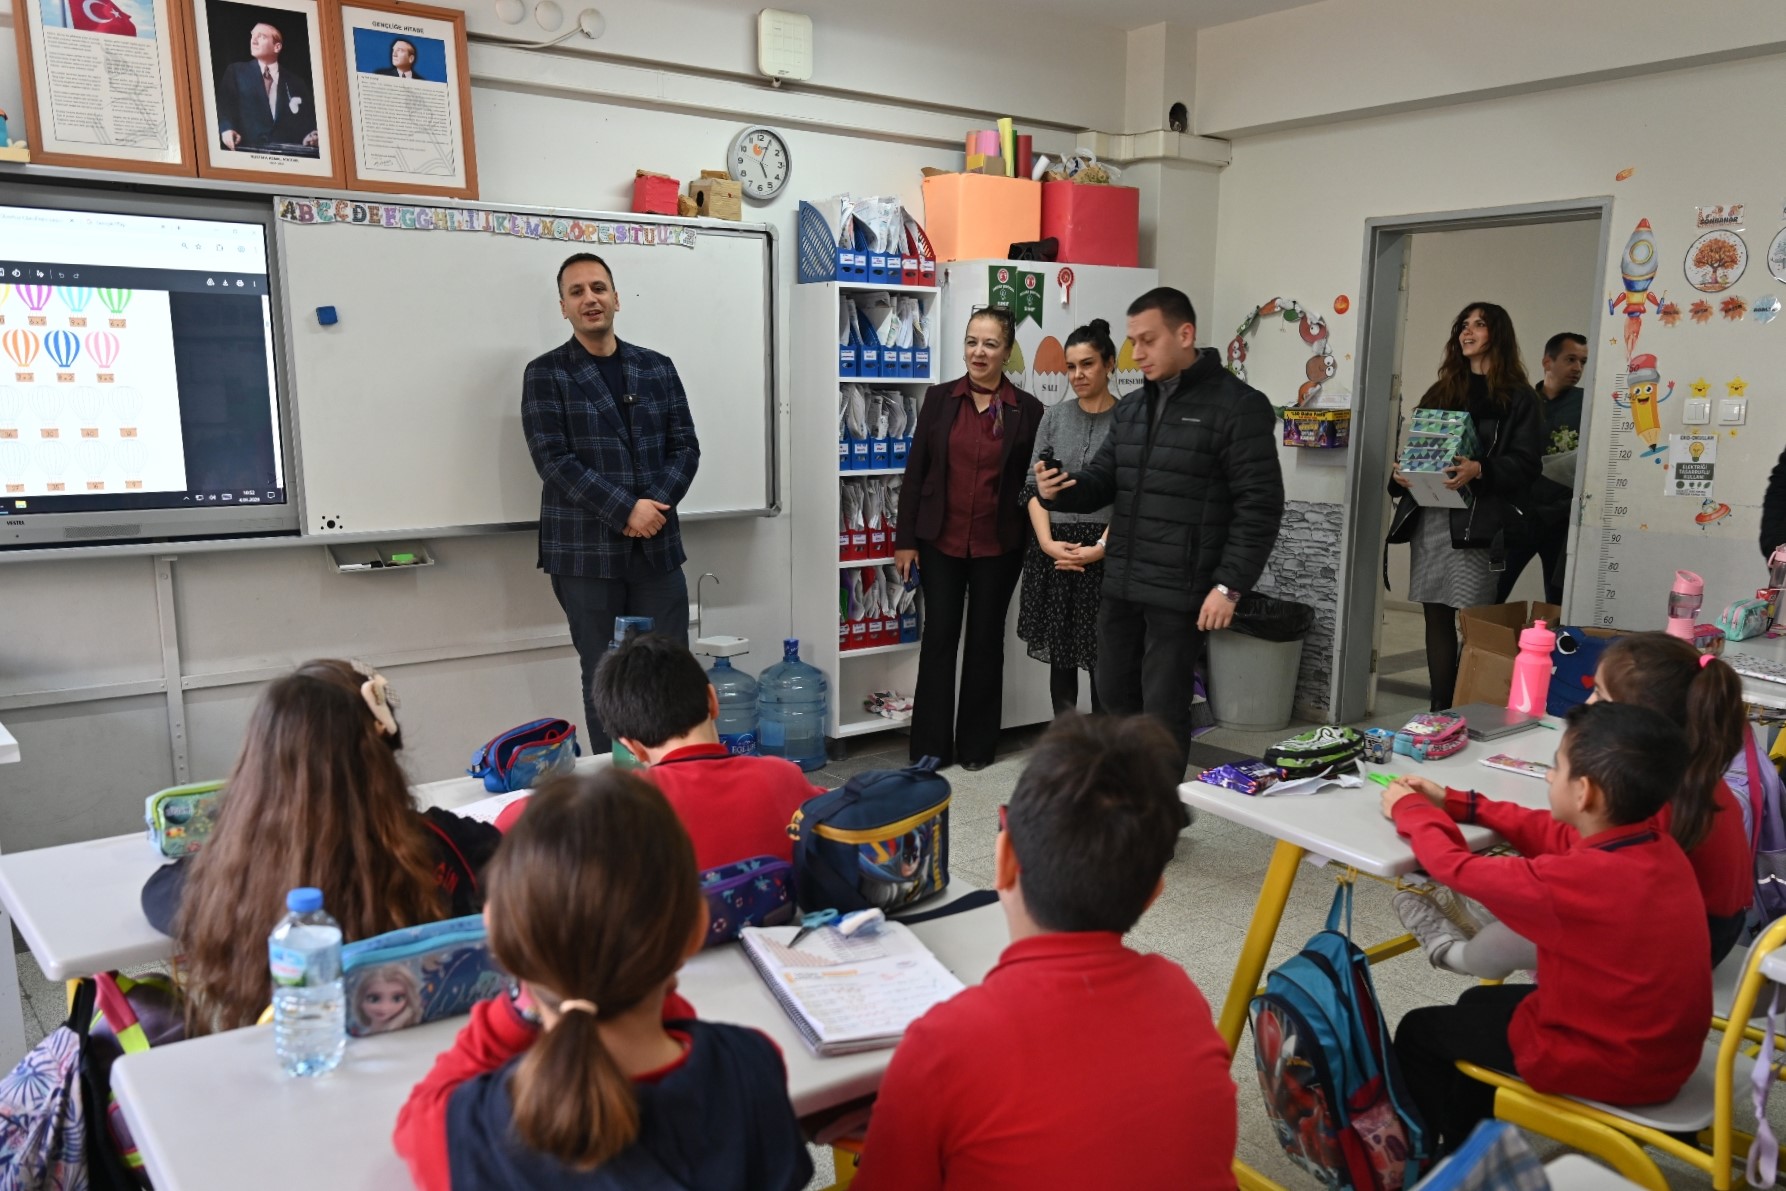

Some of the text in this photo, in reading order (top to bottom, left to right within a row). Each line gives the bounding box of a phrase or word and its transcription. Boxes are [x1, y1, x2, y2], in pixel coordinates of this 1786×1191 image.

[1626, 364, 1640, 373] 150
[1041, 384, 1058, 392] SALI
[1621, 422, 1635, 430] 130
[1618, 450, 1632, 459] 120
[1615, 479, 1628, 487] 110
[1613, 506, 1628, 515] 100
[1611, 534, 1621, 542] 90
[1608, 562, 1619, 571] 80
[1606, 590, 1616, 598] 70
[1603, 616, 1614, 624] 60
